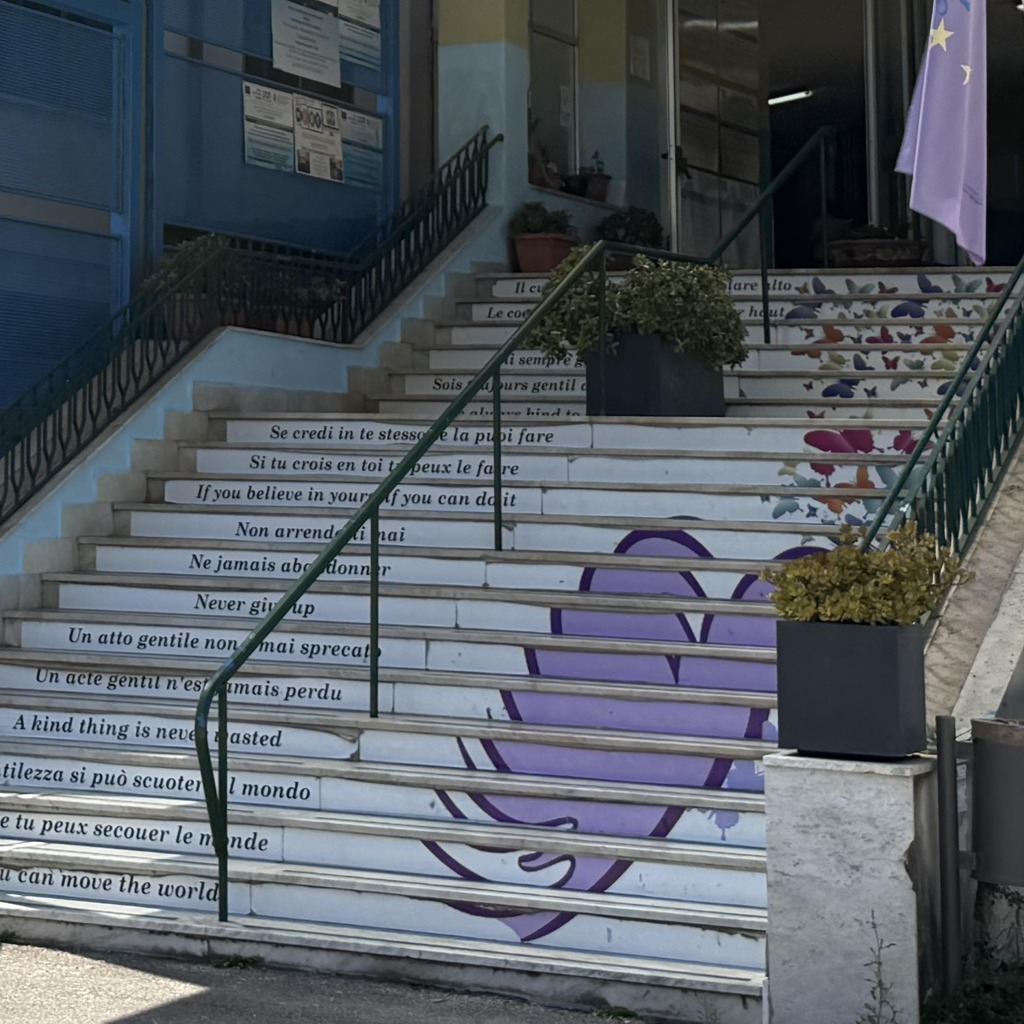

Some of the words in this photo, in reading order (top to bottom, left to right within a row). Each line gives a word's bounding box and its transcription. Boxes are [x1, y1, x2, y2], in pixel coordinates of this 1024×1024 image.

[514, 281, 525, 294] Il
[728, 277, 758, 291] lare
[487, 307, 503, 319] Le
[432, 378, 463, 391] Sois
[531, 378, 576, 393] gentil
[270, 424, 288, 440] Se
[292, 425, 334, 440] credi
[338, 426, 355, 440] in
[359, 427, 374, 441] te
[378, 428, 426, 441] stesso
[453, 427, 469, 442] la
[517, 428, 554, 446] fare
[249, 455, 266, 470] Si
[271, 458, 287, 471] tu
[292, 456, 332, 471] crois
[336, 460, 356, 472] en
[361, 458, 383, 472] toi
[409, 462, 452, 476] peux
[456, 459, 472, 474] le
[476, 460, 520, 477] fare
[196, 483, 212, 501] If
[212, 488, 241, 503] you
[246, 485, 303, 501] believe
[307, 487, 324, 502] in
[327, 488, 400, 507] yourlf
[401, 492, 432, 507] you
[437, 494, 471, 506] can
[475, 491, 496, 507] do
[502, 492, 517, 508] it
[234, 521, 269, 538] Non
[188, 553, 212, 570] Ne
[213, 555, 276, 574] jamais
[194, 593, 246, 611] Never
[248, 596, 277, 616] giv
[292, 602, 315, 618] up
[68, 626, 93, 644] Un
[97, 631, 134, 646] atto
[136, 632, 200, 649] gentile
[204, 638, 238, 651] non
[258, 638, 296, 654] mai
[35, 667, 60, 684] Un
[65, 670, 103, 686] acte
[106, 674, 160, 691] gentil
[215, 680, 280, 697] amais
[283, 682, 343, 702] perdu
[12, 714, 26, 730] A
[30, 714, 74, 733] kind
[78, 717, 130, 741] thing
[134, 720, 152, 739] is
[155, 726, 208, 742] neve
[69, 766, 86, 784] si
[89, 769, 127, 789] può
[132, 775, 203, 792] scuoter
[241, 781, 312, 801] mondo
[15, 813, 35, 831] tu
[39, 818, 88, 836] peux
[93, 823, 170, 843] secouer
[175, 825, 193, 845] le
[199, 832, 269, 852] mnde
[18, 869, 55, 886] can
[61, 873, 112, 891] move
[118, 874, 151, 895] the
[158, 880, 220, 902] world
